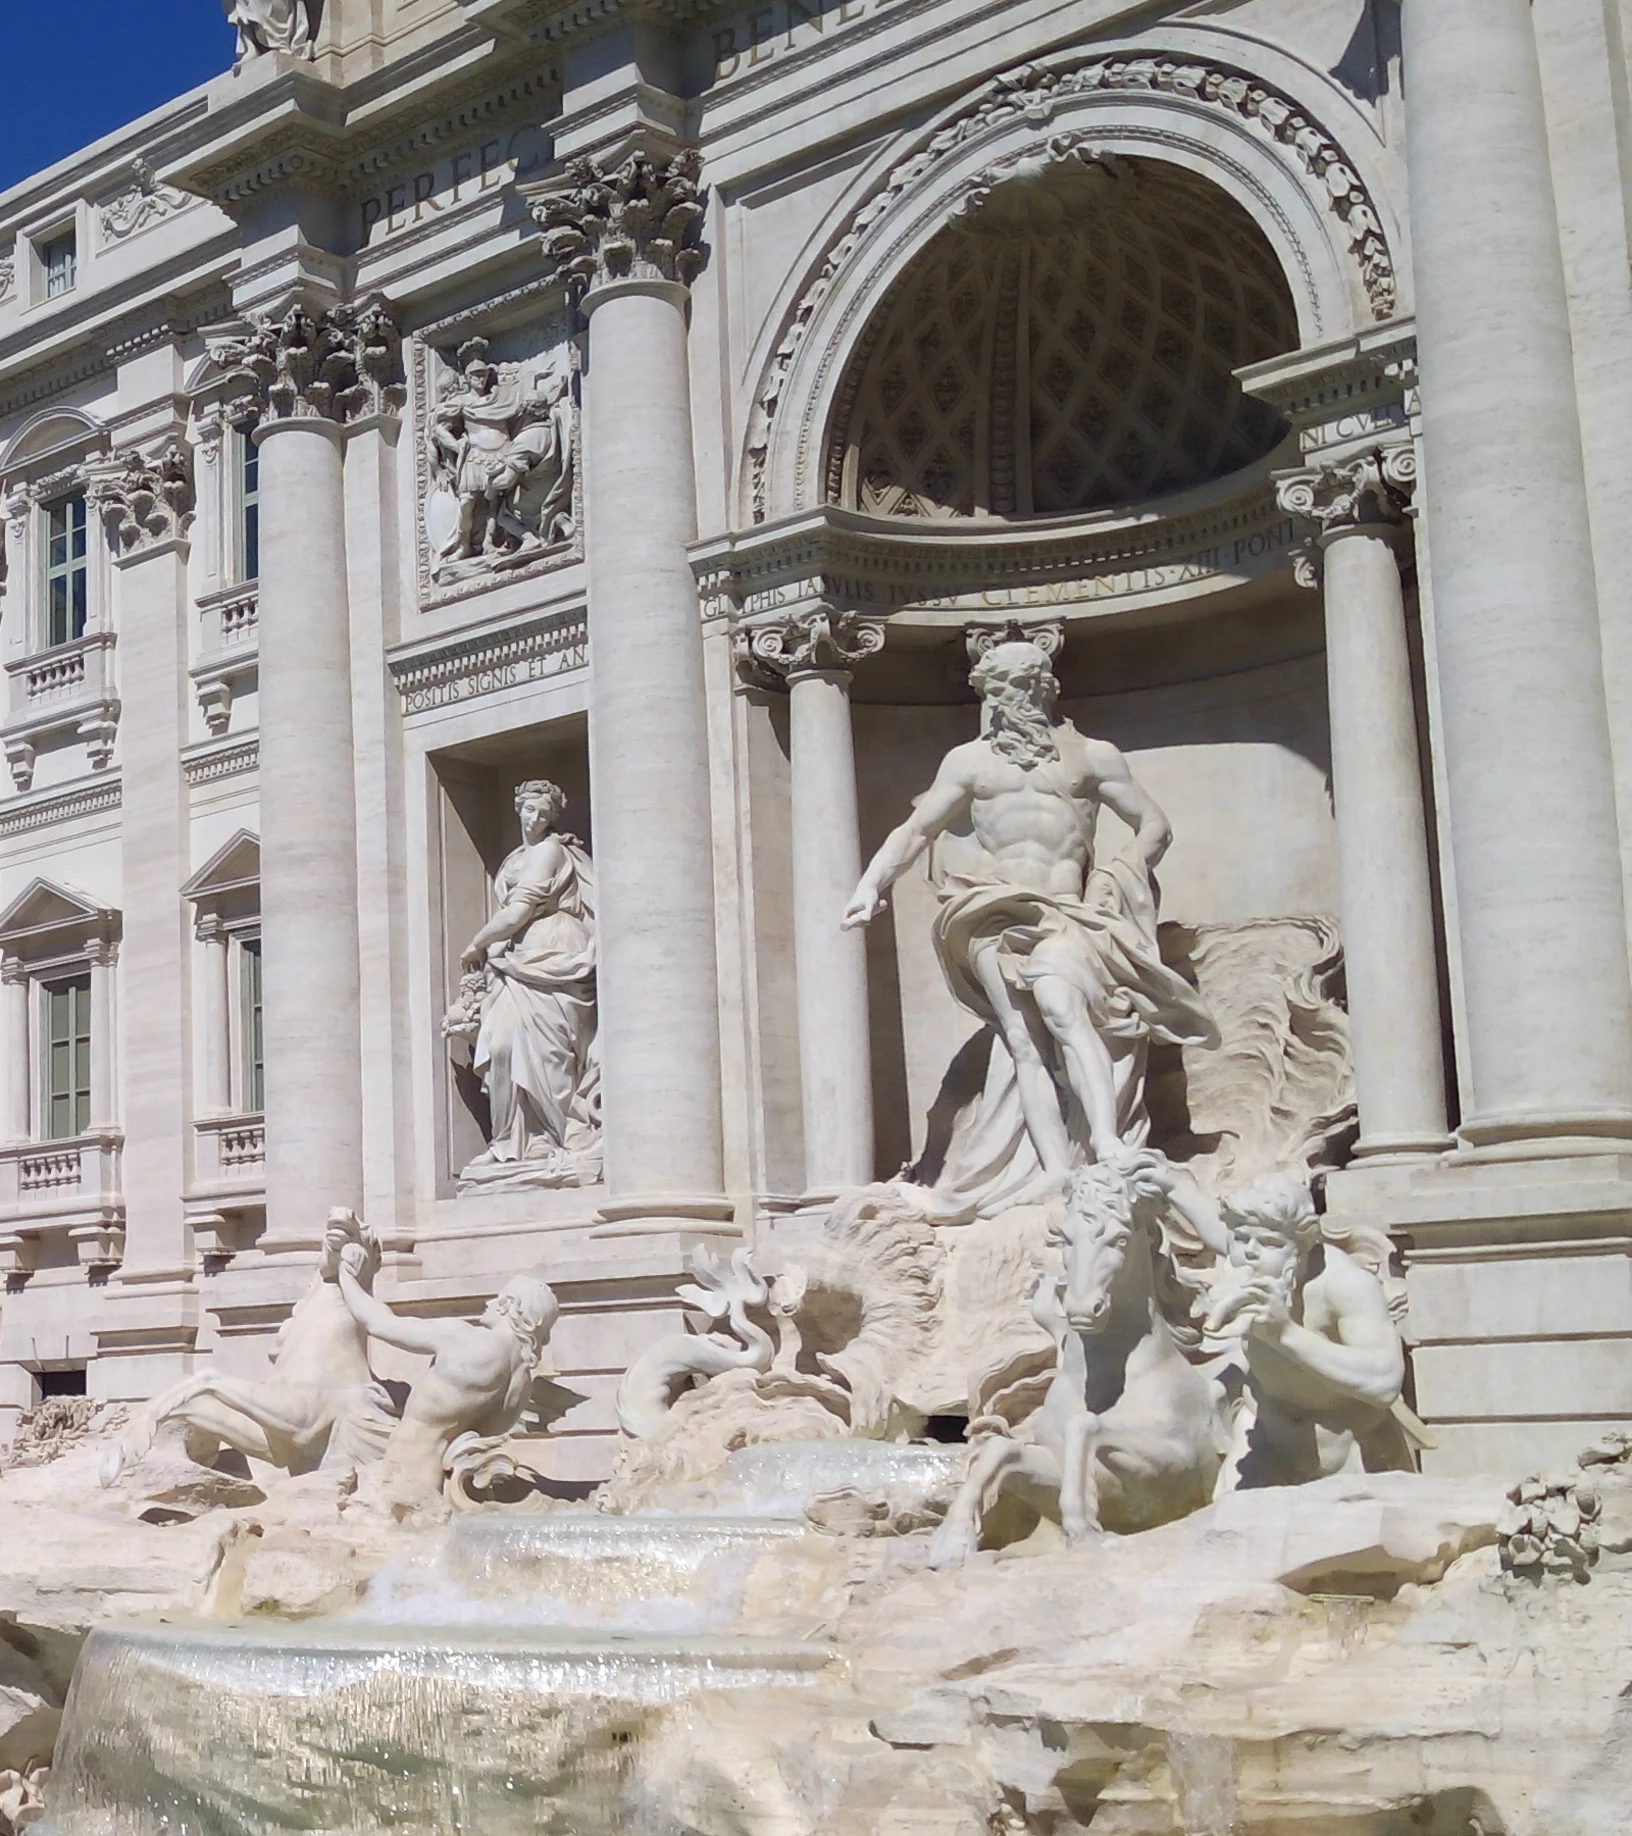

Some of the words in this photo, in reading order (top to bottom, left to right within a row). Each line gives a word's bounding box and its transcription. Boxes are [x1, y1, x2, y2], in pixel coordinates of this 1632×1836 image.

[710, 0, 890, 81] BENE
[703, 585, 786, 618] GLPHIS
[981, 567, 1166, 607] CLEMENTIS
[404, 681, 460, 713] POSITIS
[468, 664, 517, 696] SIGNIS
[528, 656, 547, 679] ET
